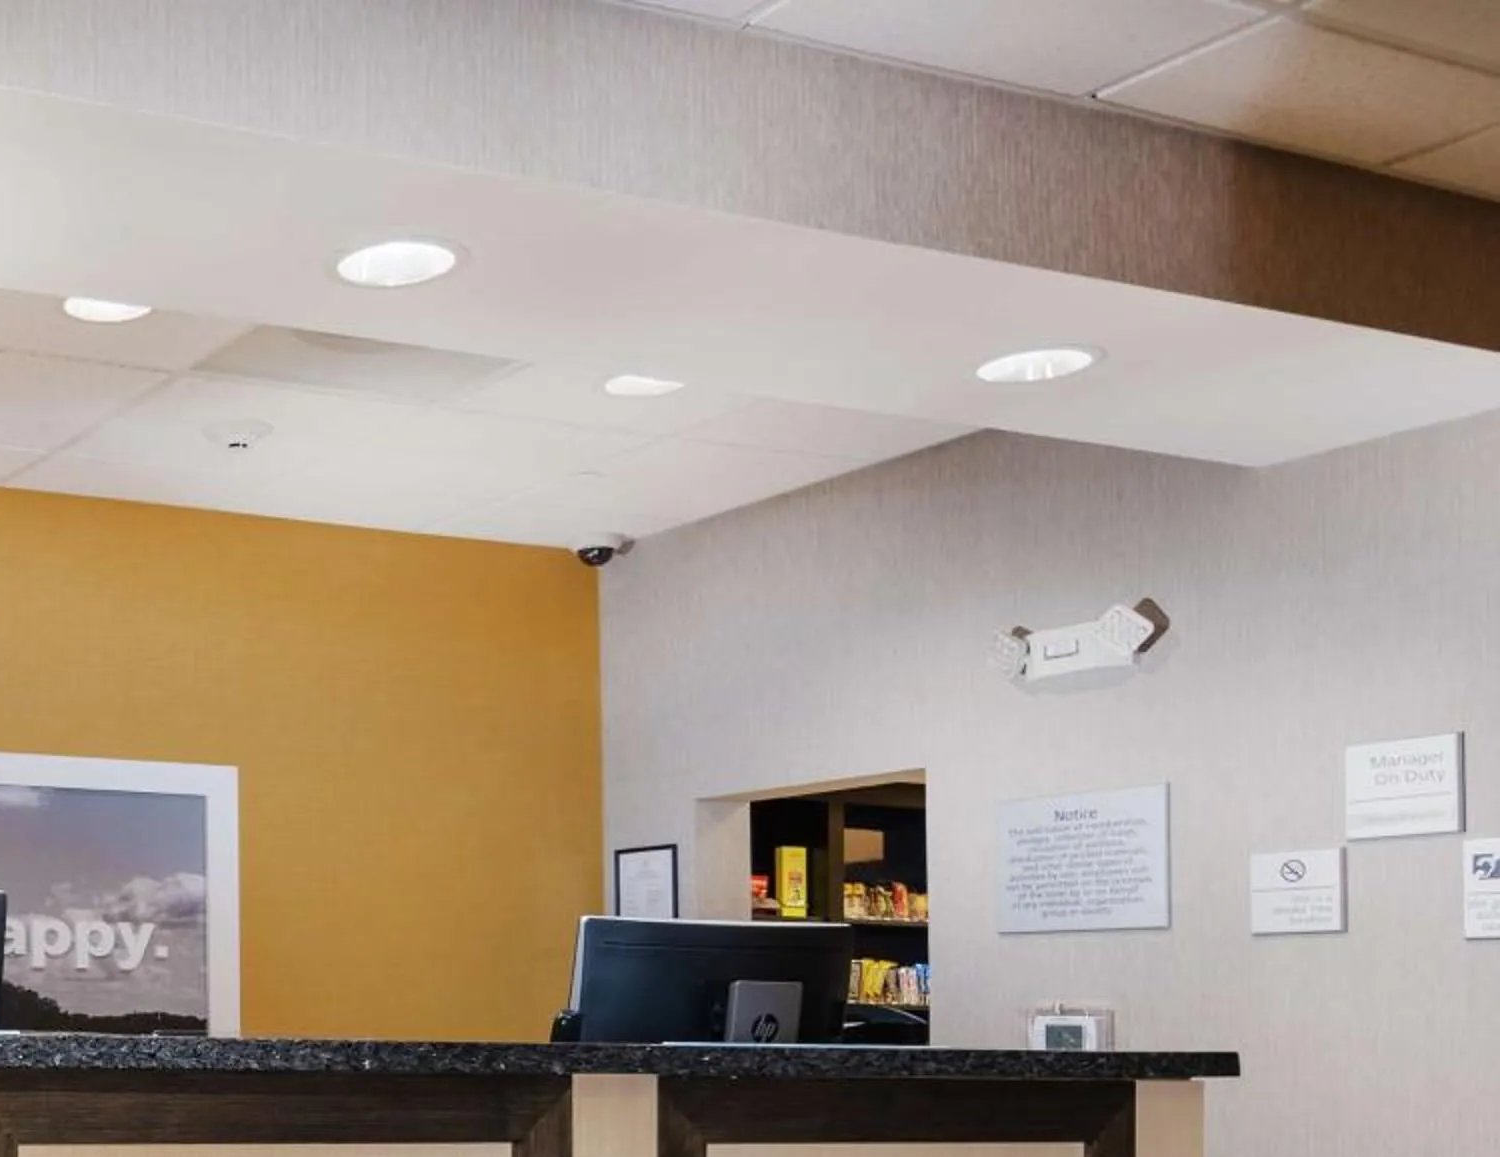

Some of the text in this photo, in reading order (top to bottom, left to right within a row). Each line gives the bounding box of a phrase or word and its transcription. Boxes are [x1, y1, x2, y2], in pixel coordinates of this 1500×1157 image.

[1370, 751, 1444, 769] Manager
[1374, 769, 1445, 786] On Duty
[1053, 809, 1098, 822] Notice
